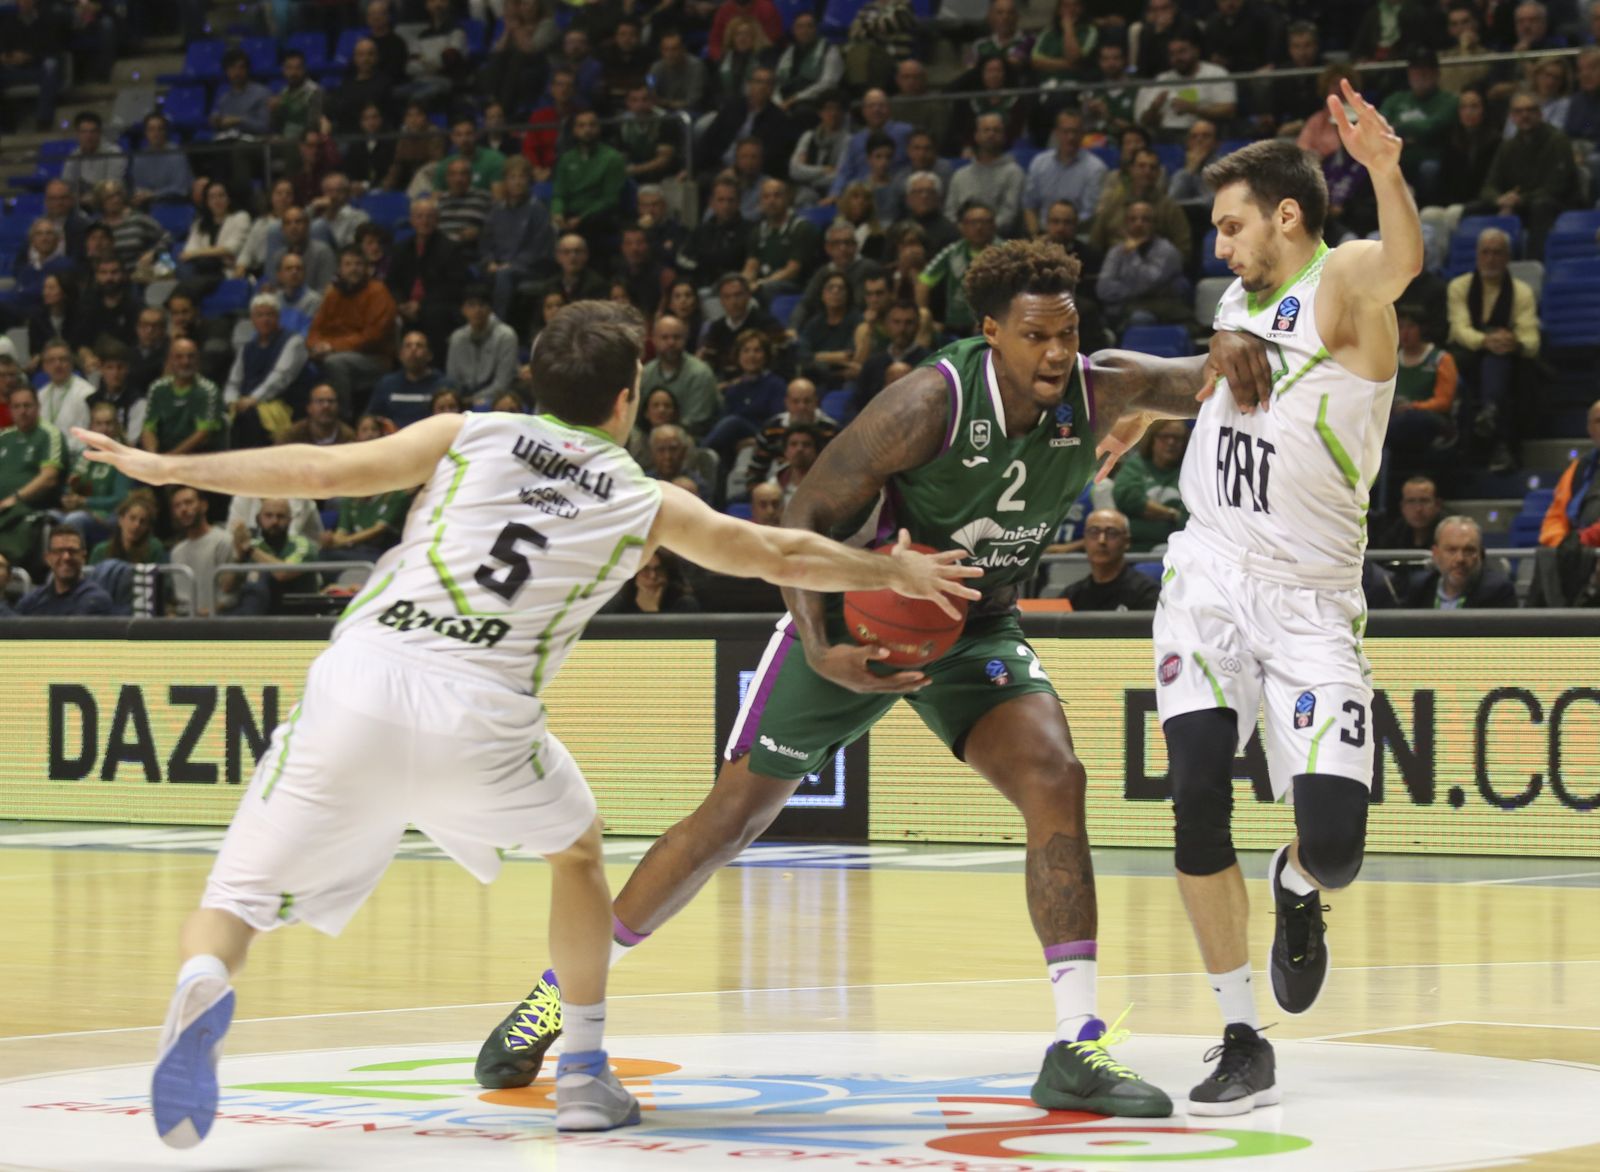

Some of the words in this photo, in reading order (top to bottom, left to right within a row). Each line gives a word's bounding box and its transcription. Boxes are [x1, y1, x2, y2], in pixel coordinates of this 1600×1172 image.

[996, 459, 1027, 512] 2
[474, 520, 549, 605] 5
[1016, 644, 1048, 679] 2
[48, 684, 280, 784] DAZN
[1340, 699, 1366, 749] 3
[23, 1101, 413, 1133] EURPEAN
